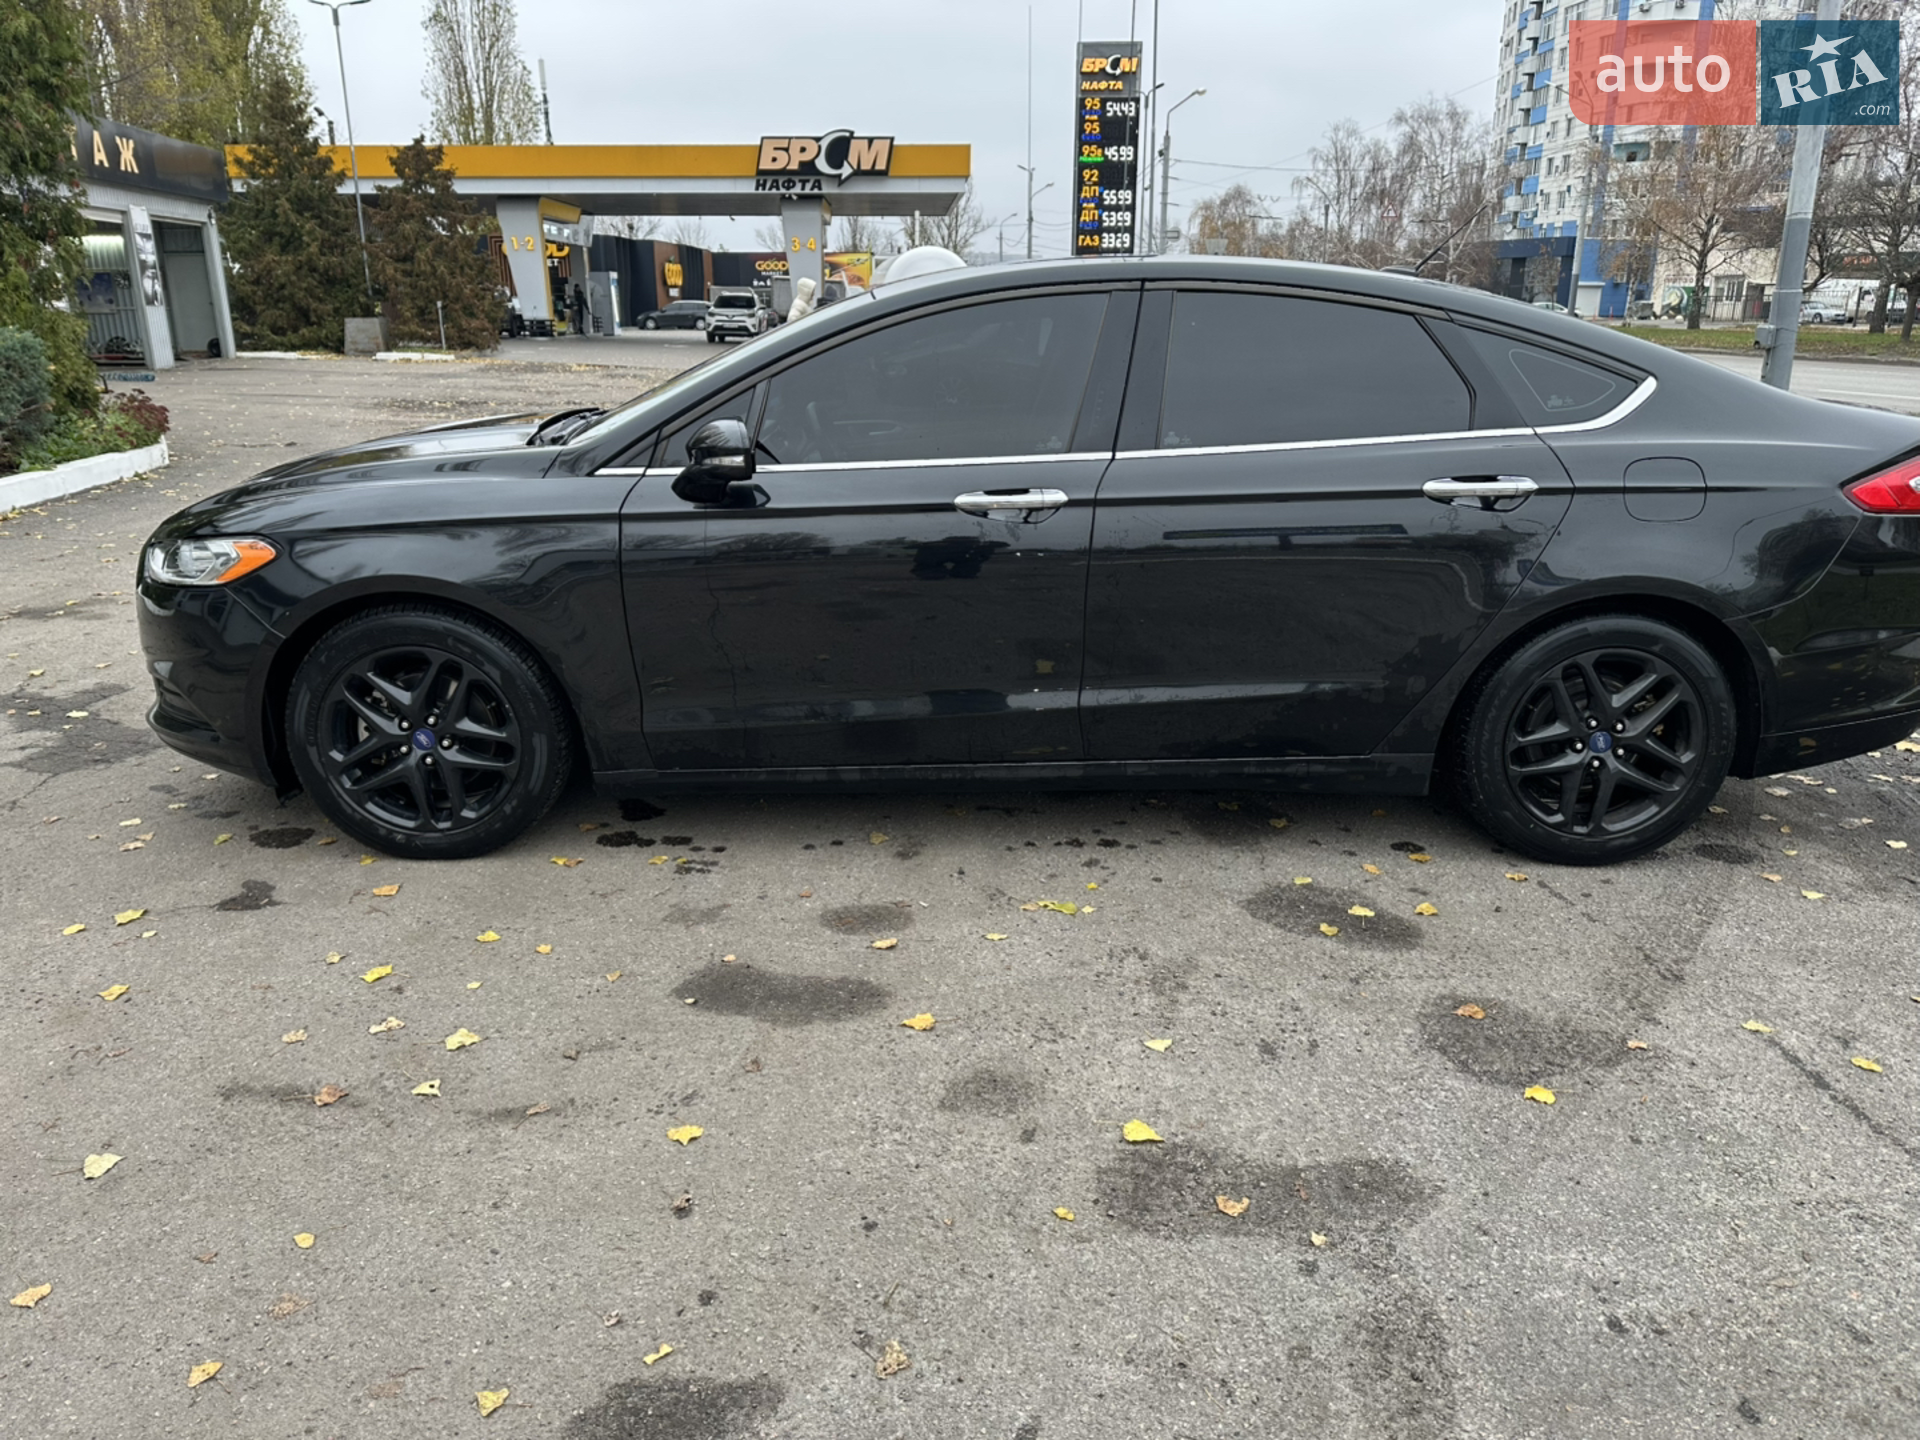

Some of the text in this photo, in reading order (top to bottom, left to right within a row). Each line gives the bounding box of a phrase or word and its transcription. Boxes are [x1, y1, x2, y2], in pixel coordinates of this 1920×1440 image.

[1081, 80, 1123, 91] НАФТА
[1084, 98, 1101, 110] 95
[1084, 122, 1100, 134] 95
[758, 131, 891, 181] БРСМ
[1082, 169, 1099, 181] 92
[754, 178, 823, 191] НАФТА
[1081, 186, 1099, 198] ДП
[1080, 209, 1099, 222] ДП
[511, 236, 534, 251] 1-2
[1078, 235, 1100, 246] ГАЗ
[755, 260, 789, 271] GOOD
